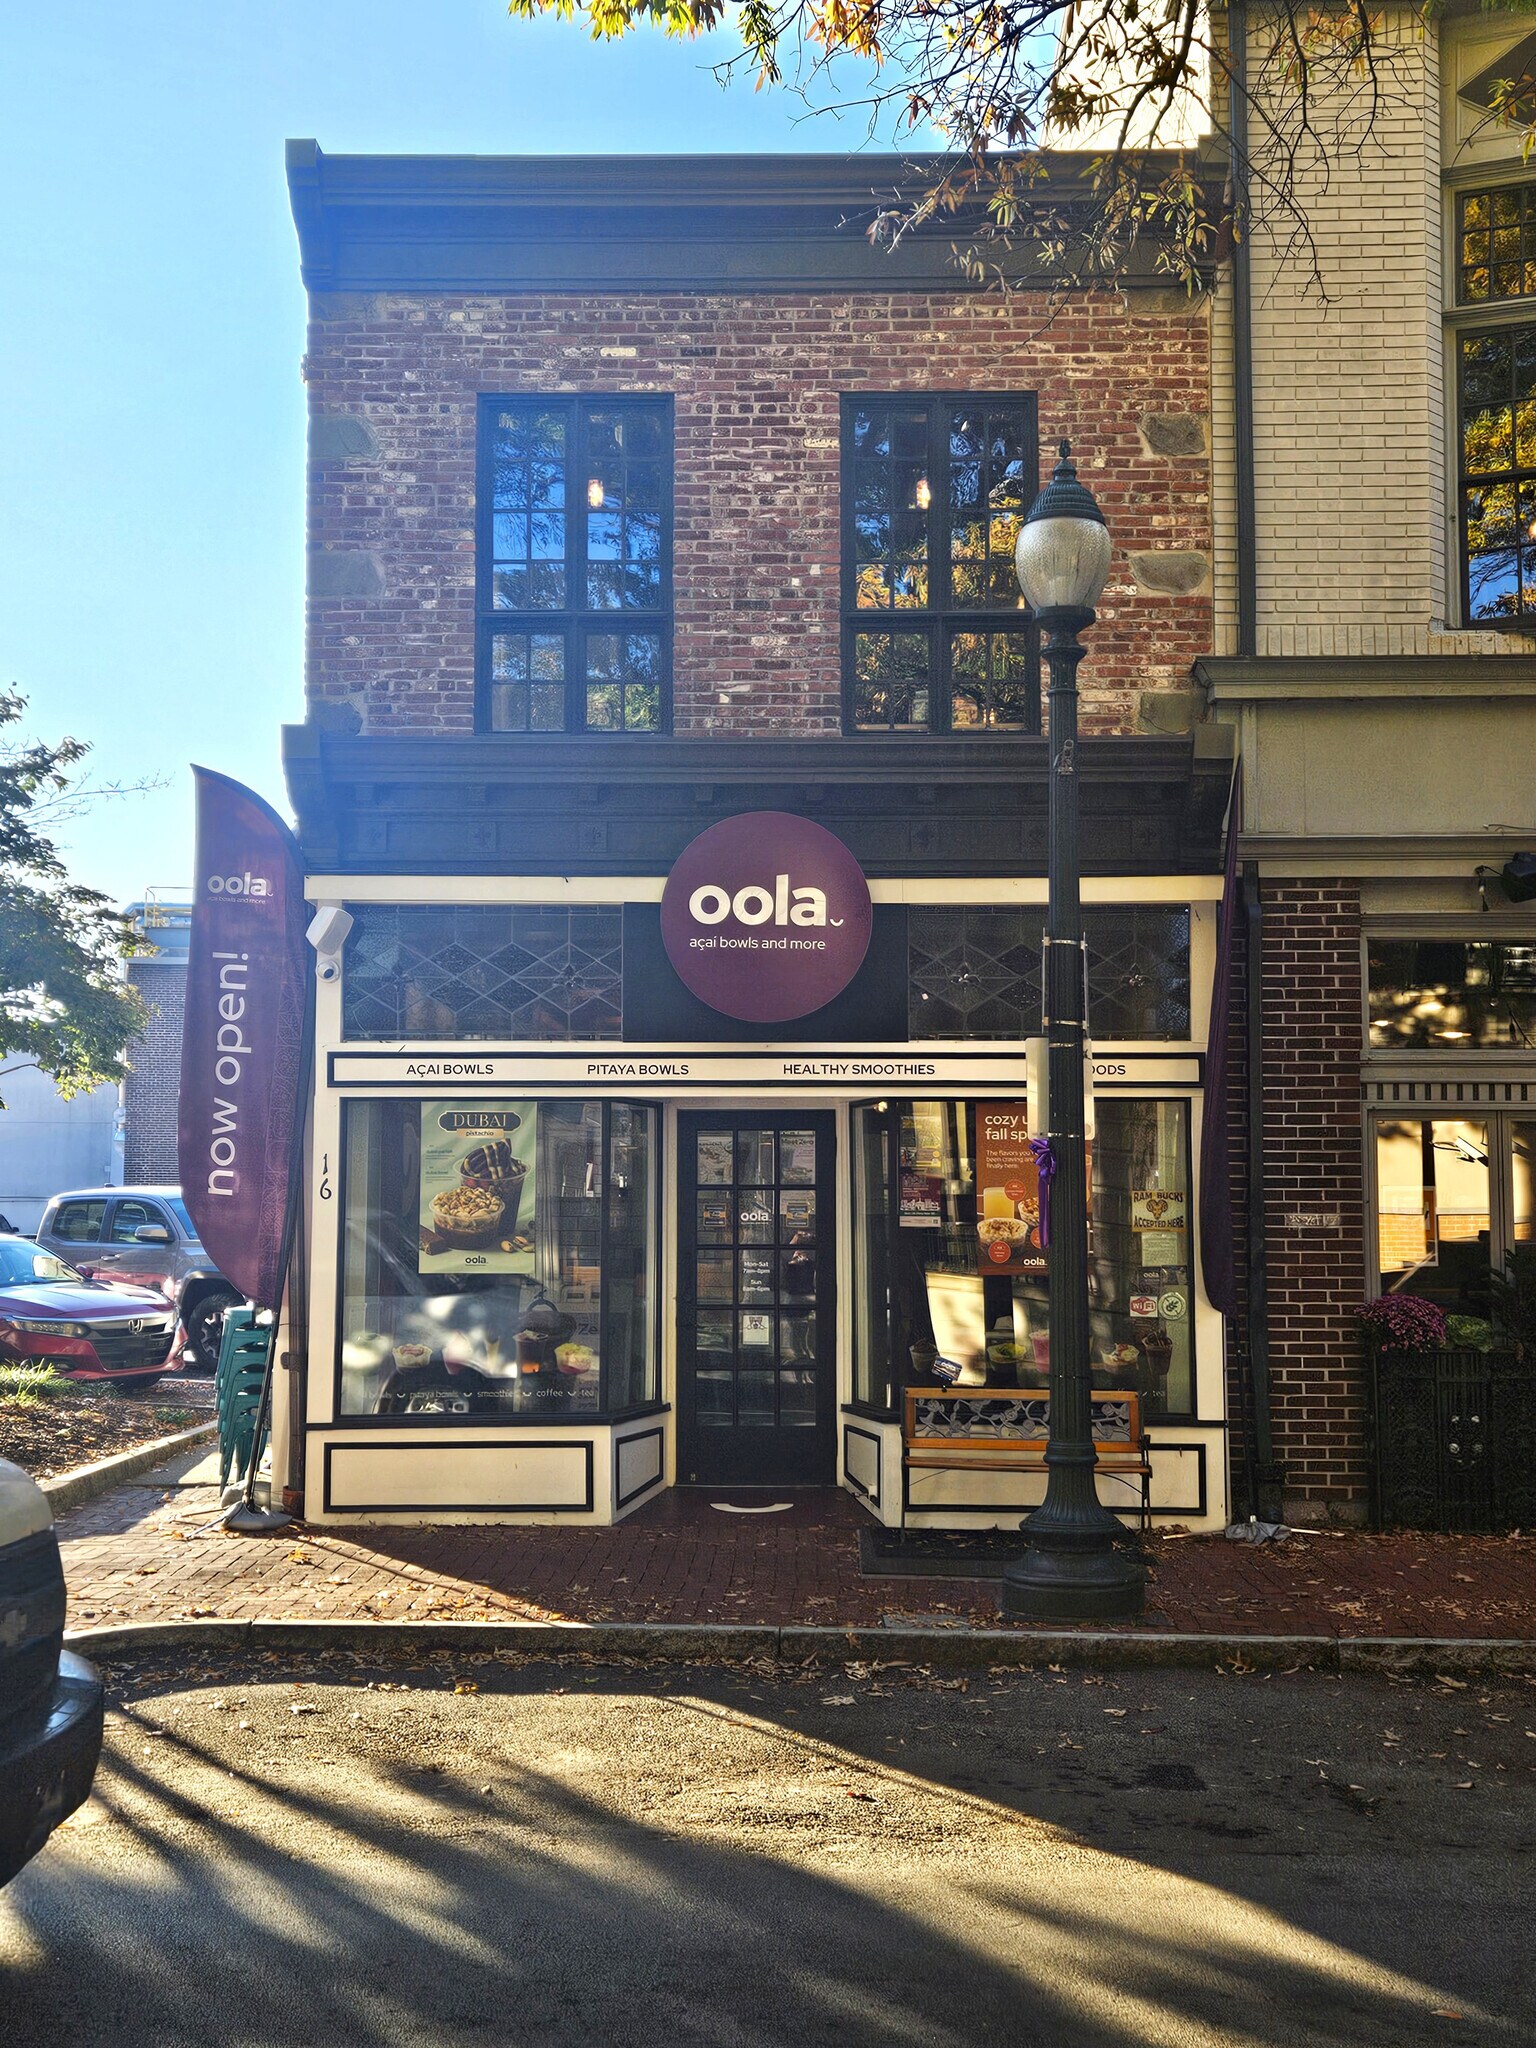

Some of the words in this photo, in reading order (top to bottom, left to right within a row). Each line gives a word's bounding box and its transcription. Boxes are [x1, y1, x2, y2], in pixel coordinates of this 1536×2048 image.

[208, 872, 267, 896] oola
[689, 874, 827, 927] oola
[689, 935, 718, 951] açaí
[719, 936, 759, 949] bowls
[761, 937, 787, 949] and
[790, 939, 826, 950] more
[212, 951, 252, 1086] open!
[406, 1064, 440, 1078] AÇAI
[443, 1064, 494, 1075] BOWLS
[587, 1064, 636, 1076] PITAYA
[638, 1064, 690, 1076] BOWLS
[783, 1063, 849, 1075] HEALTHY
[851, 1064, 936, 1076] SMOOTHIES
[453, 1113, 506, 1127] DUBAI
[984, 1115, 1019, 1128] cozy
[985, 1127, 1007, 1140] fall
[207, 1097, 238, 1196] now
[1133, 1191, 1152, 1203] RAM
[1156, 1191, 1184, 1203] BUCKS
[740, 1210, 769, 1221] oola
[1133, 1215, 1167, 1228] ACCEPTED
[1167, 1215, 1184, 1228] HERE
[465, 1255, 487, 1264] oola
[1023, 1256, 1046, 1266] oola
[536, 1388, 564, 1398] coffee
